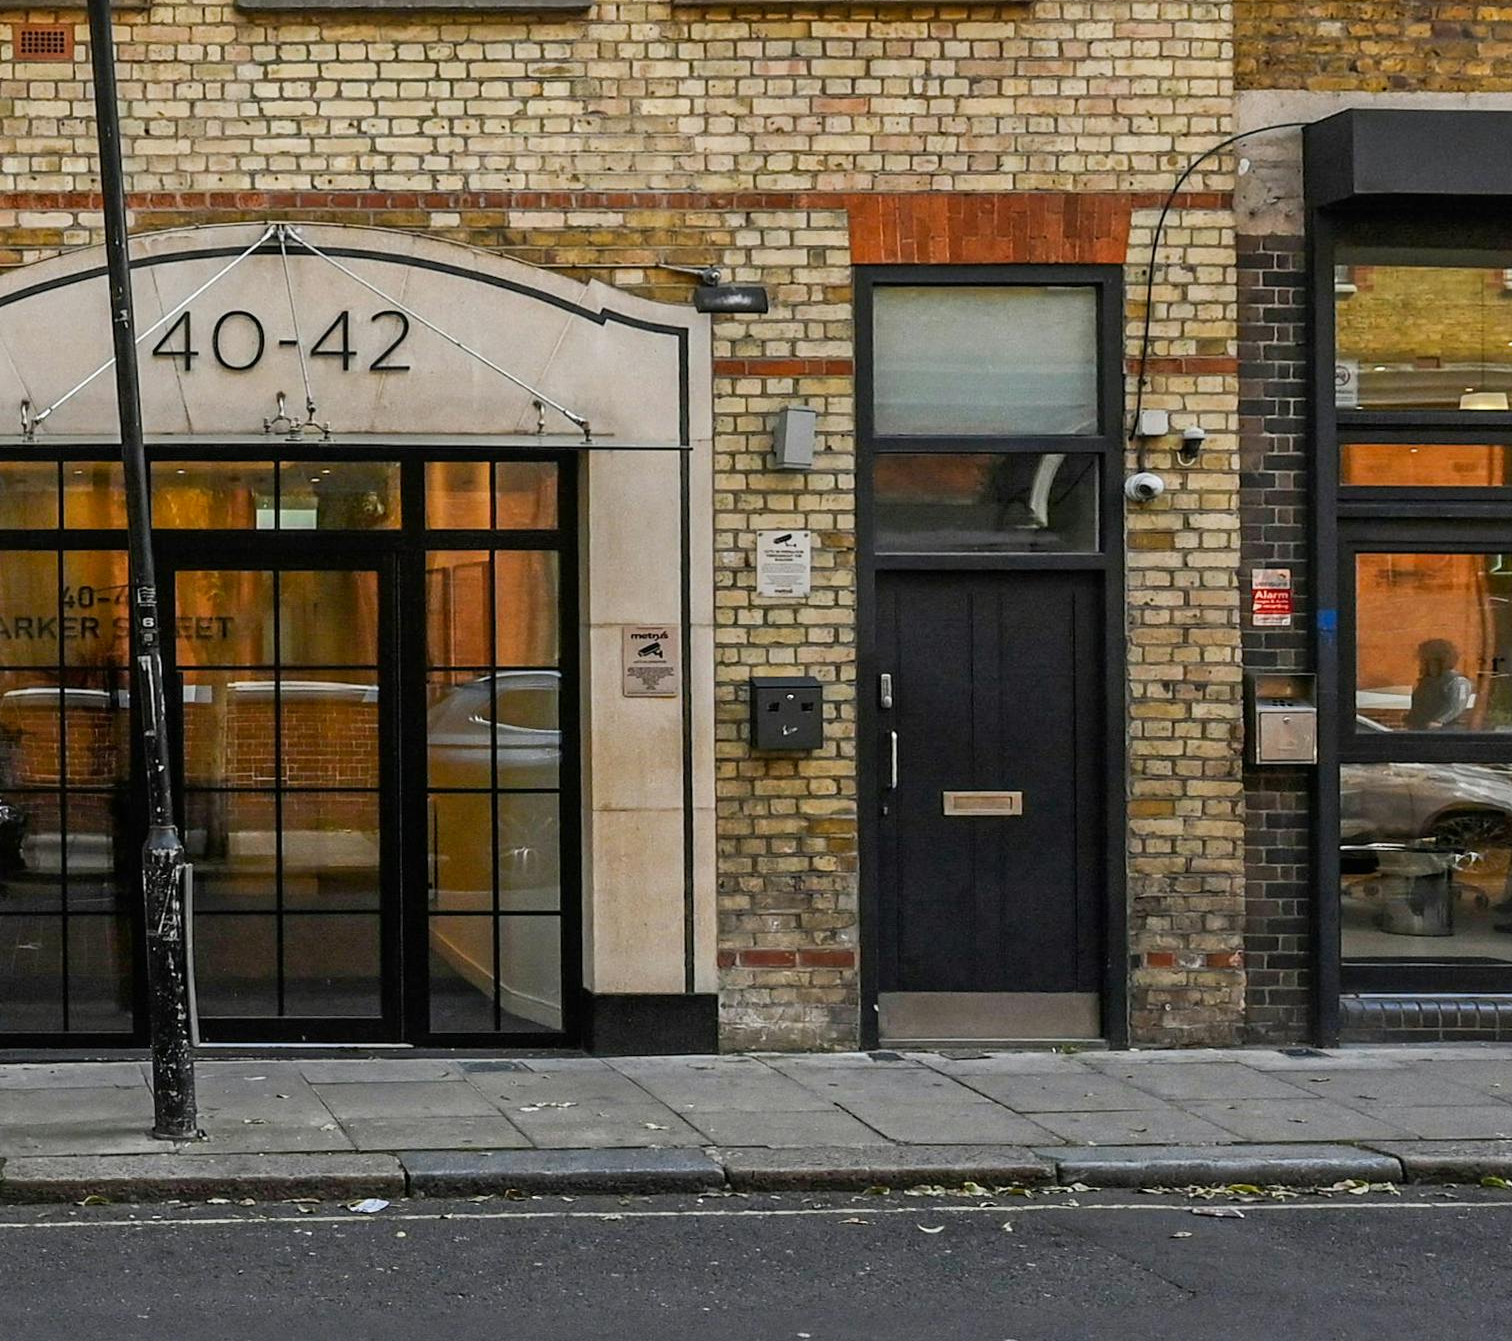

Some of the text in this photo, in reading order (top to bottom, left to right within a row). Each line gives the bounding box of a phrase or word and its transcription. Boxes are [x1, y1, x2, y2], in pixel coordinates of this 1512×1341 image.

[152, 310, 411, 372] 40-42
[1255, 590, 1289, 599] Alarm
[112, 616, 234, 640] SEET
